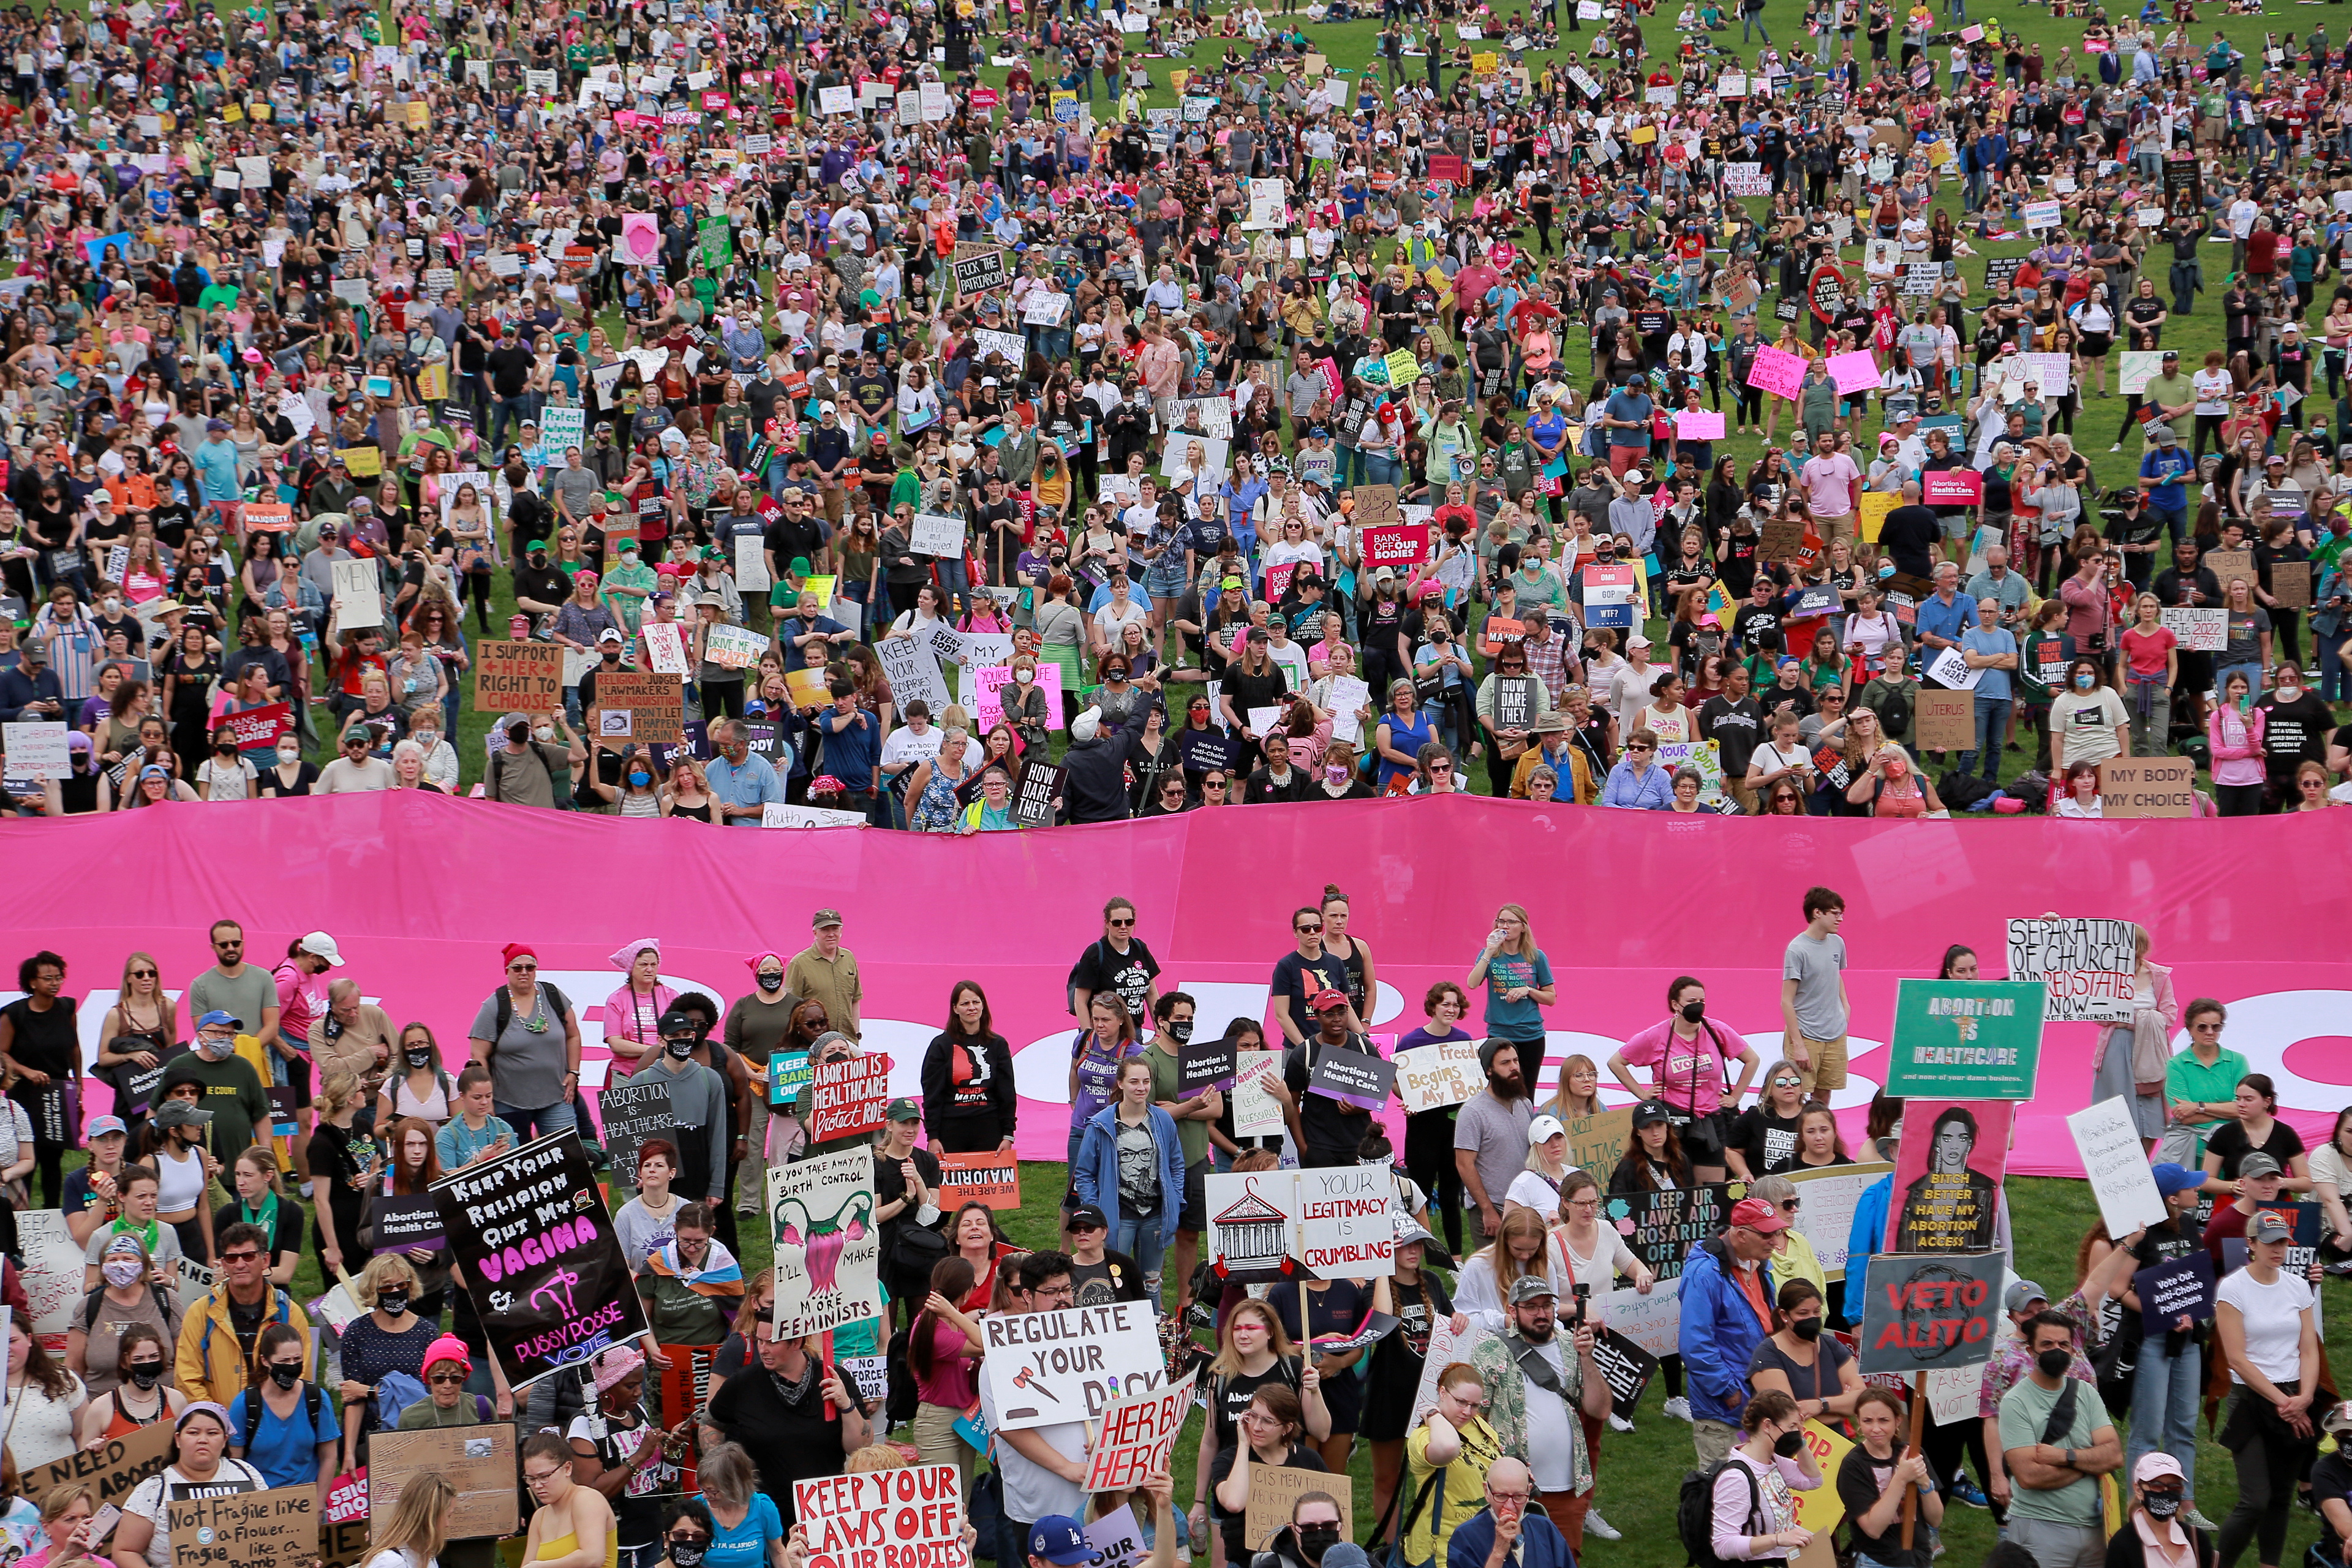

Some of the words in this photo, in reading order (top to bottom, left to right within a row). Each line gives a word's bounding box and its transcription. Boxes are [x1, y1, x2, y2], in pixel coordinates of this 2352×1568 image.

[958, 261, 980, 277] FUCK
[980, 256, 998, 271] THE
[961, 269, 1003, 292] PATRIARCHY
[1717, 268, 1737, 284] TAKE
[1718, 281, 1731, 293] YOUR
[1730, 276, 1745, 285] LAWS
[1730, 292, 1743, 302] BODY
[1817, 283, 1839, 294] VOTE
[1758, 346, 1798, 366] Abortion
[1757, 358, 1795, 377] Healthcare
[1751, 371, 1777, 391] Human
[1307, 460, 1330, 469] 1973
[1357, 490, 1387, 503] What
[1374, 533, 1400, 543] BANS
[1374, 542, 1394, 551] OFF
[1395, 540, 1418, 550] OUR
[1374, 548, 1414, 559] BODIES
[336, 561, 379, 595] MEN
[1600, 573, 1616, 582] OMG
[1602, 590, 1615, 599] GOP
[1600, 609, 1618, 619] WTF?
[655, 624, 669, 634] YOU
[481, 646, 490, 658] I
[496, 646, 557, 661] SUPPORT
[661, 650, 674, 663] ME!
[502, 662, 538, 675] HER
[480, 676, 530, 691] RIGHT
[538, 680, 556, 692] TO
[597, 674, 641, 685] RELIGION
[648, 674, 680, 685] JUDGES
[604, 685, 670, 695] LAWMAKERS
[1920, 693, 1934, 704] My
[488, 692, 552, 710] CHOOSE
[604, 696, 622, 706] THE
[625, 696, 681, 706] INQUISITION
[1926, 704, 1964, 715] UTERUS
[665, 707, 681, 718] LET
[634, 719, 642, 728] IT
[643, 718, 680, 728] HAPPEN
[636, 729, 680, 741] AGAIN!
[1921, 730, 1943, 740] belong
[1940, 737, 1965, 746] state
[1191, 748, 1227, 760] Anti-Choice
[1191, 755, 1223, 766] Politicians
[1028, 763, 1057, 785] HOW
[2111, 769, 2136, 782] MY
[2144, 769, 2188, 781] BODY
[1022, 780, 1052, 803] DARE
[2104, 793, 2129, 806] MY
[2134, 793, 2190, 806] CHOICE
[1018, 797, 1047, 820] THEY.
[2009, 919, 2135, 949] SEPARATION
[2014, 946, 2037, 973] OF
[2045, 946, 2133, 971] CHURCH
[1929, 998, 2014, 1016] ABORTION
[2078, 1012, 2114, 1020] SILENCED
[1914, 1047, 2018, 1065] HEALTHCARE
[815, 1058, 867, 1087] ABORTION
[870, 1055, 882, 1076] IS
[1325, 1060, 1368, 1078] Abortion
[1370, 1072, 1379, 1082] is
[1323, 1069, 1354, 1085] Health
[1356, 1079, 1381, 1093] Care.
[815, 1076, 887, 1109] HEALTHCARE
[815, 1104, 861, 1140] Protect
[862, 1099, 886, 1125] ROE
[772, 1170, 781, 1182] IF
[786, 1167, 803, 1180] YOU
[807, 1162, 827, 1175] TAKE
[832, 1159, 854, 1169] AWAY
[858, 1155, 868, 1167] MY
[779, 1183, 813, 1197] BIRTH
[822, 1173, 864, 1185] CONTROL
[1320, 1172, 1375, 1196] YOUR
[1931, 1174, 1970, 1184] BITCH
[1924, 1190, 1972, 1200] BETTER
[1304, 1198, 1389, 1220] LEGITIMACY
[1917, 1205, 1952, 1215] HAVE
[1956, 1205, 1975, 1215] MY
[1339, 1222, 1352, 1236] IS
[1909, 1221, 1977, 1231] ABORTION
[478, 1216, 597, 1283] VAGINA
[1918, 1237, 1964, 1247] ACCESS
[843, 1247, 875, 1266] MAKE
[1305, 1241, 1392, 1267] CRUMBLING
[778, 1264, 801, 1283] I'LL
[2158, 1277, 2178, 1289] Vote
[2180, 1271, 2195, 1283] Out
[1885, 1280, 1989, 1310] VETO
[2155, 1281, 2203, 1304] Anti-Choice
[489, 1291, 514, 1314] &
[801, 1292, 843, 1315] MORE
[2160, 1295, 2202, 1314] Politicians
[778, 1300, 871, 1340] FEMINISTS
[988, 1306, 1131, 1348] REGULATE
[516, 1324, 570, 1363] PUSSY
[568, 1301, 624, 1343] POSSE
[1875, 1317, 1989, 1349] ALITO
[544, 1329, 614, 1366] VOTE
[1033, 1346, 1104, 1376] YOUR
[796, 1476, 864, 1520] KEEP
[871, 1467, 958, 1506] YOUR
[169, 1501, 207, 1531] Not
[213, 1498, 268, 1525] Fragile
[275, 1498, 310, 1514] like
[800, 1508, 888, 1555] LAWS
[895, 1503, 958, 1540] OFF
[809, 1550, 878, 1568] OUR
[883, 1536, 967, 1568] BODIES
